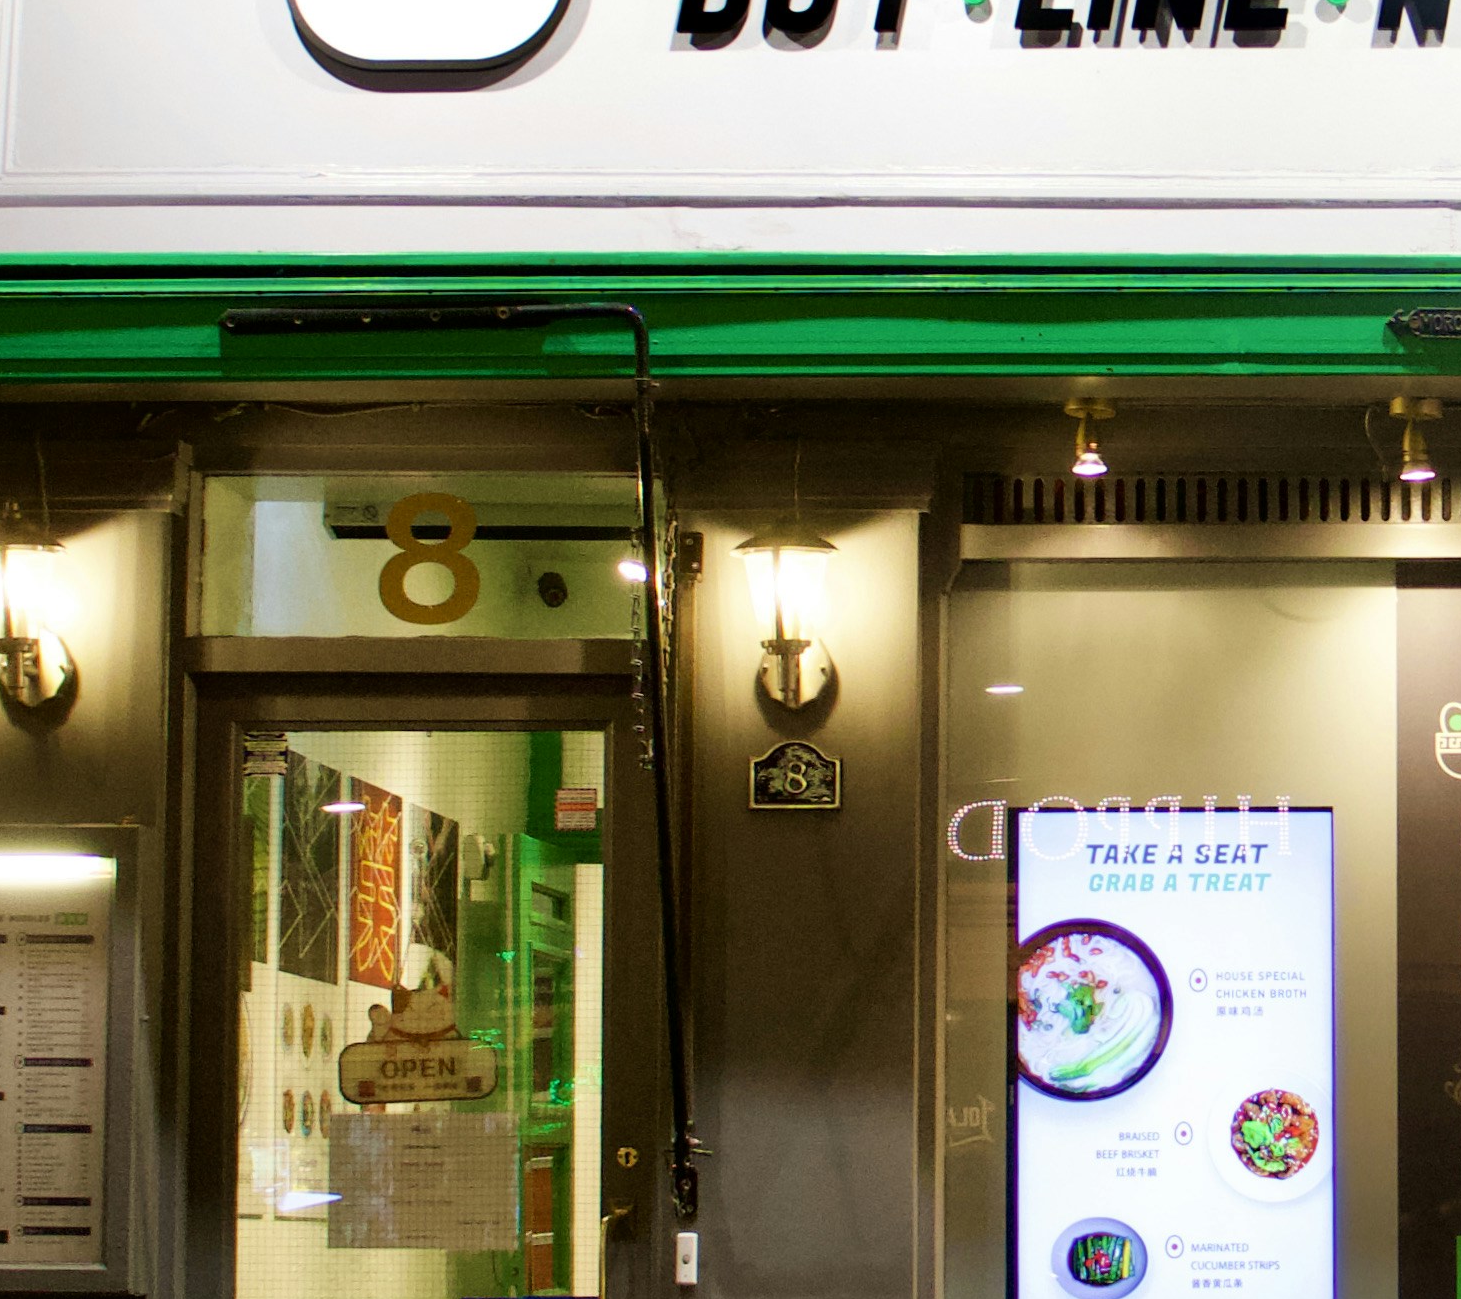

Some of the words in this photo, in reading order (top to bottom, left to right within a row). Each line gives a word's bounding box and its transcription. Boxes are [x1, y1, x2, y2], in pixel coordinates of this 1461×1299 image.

[378, 492, 481, 625] 8
[783, 761, 809, 795] 8
[1086, 843, 1159, 865] TAKE
[1168, 843, 1185, 865] A
[1194, 843, 1269, 865] SEAT
[1088, 873, 1155, 893] GRAB
[1163, 873, 1178, 893] A
[1189, 872, 1272, 893] TREAT
[1216, 971, 1255, 982] HOUSE
[1258, 971, 1306, 982] SPECIAL
[1216, 988, 1266, 999] CHICKEN
[1270, 988, 1308, 999] BROTH
[380, 1056, 457, 1080] OPEN
[1118, 1131, 1161, 1142] BRAISED
[1096, 1149, 1119, 1160] BEEF
[1121, 1149, 1160, 1160] BRISKET
[1191, 1242, 1250, 1253] MARINATED
[1191, 1260, 1246, 1271] CUCUMBER
[1248, 1260, 1281, 1271] STRIPS
